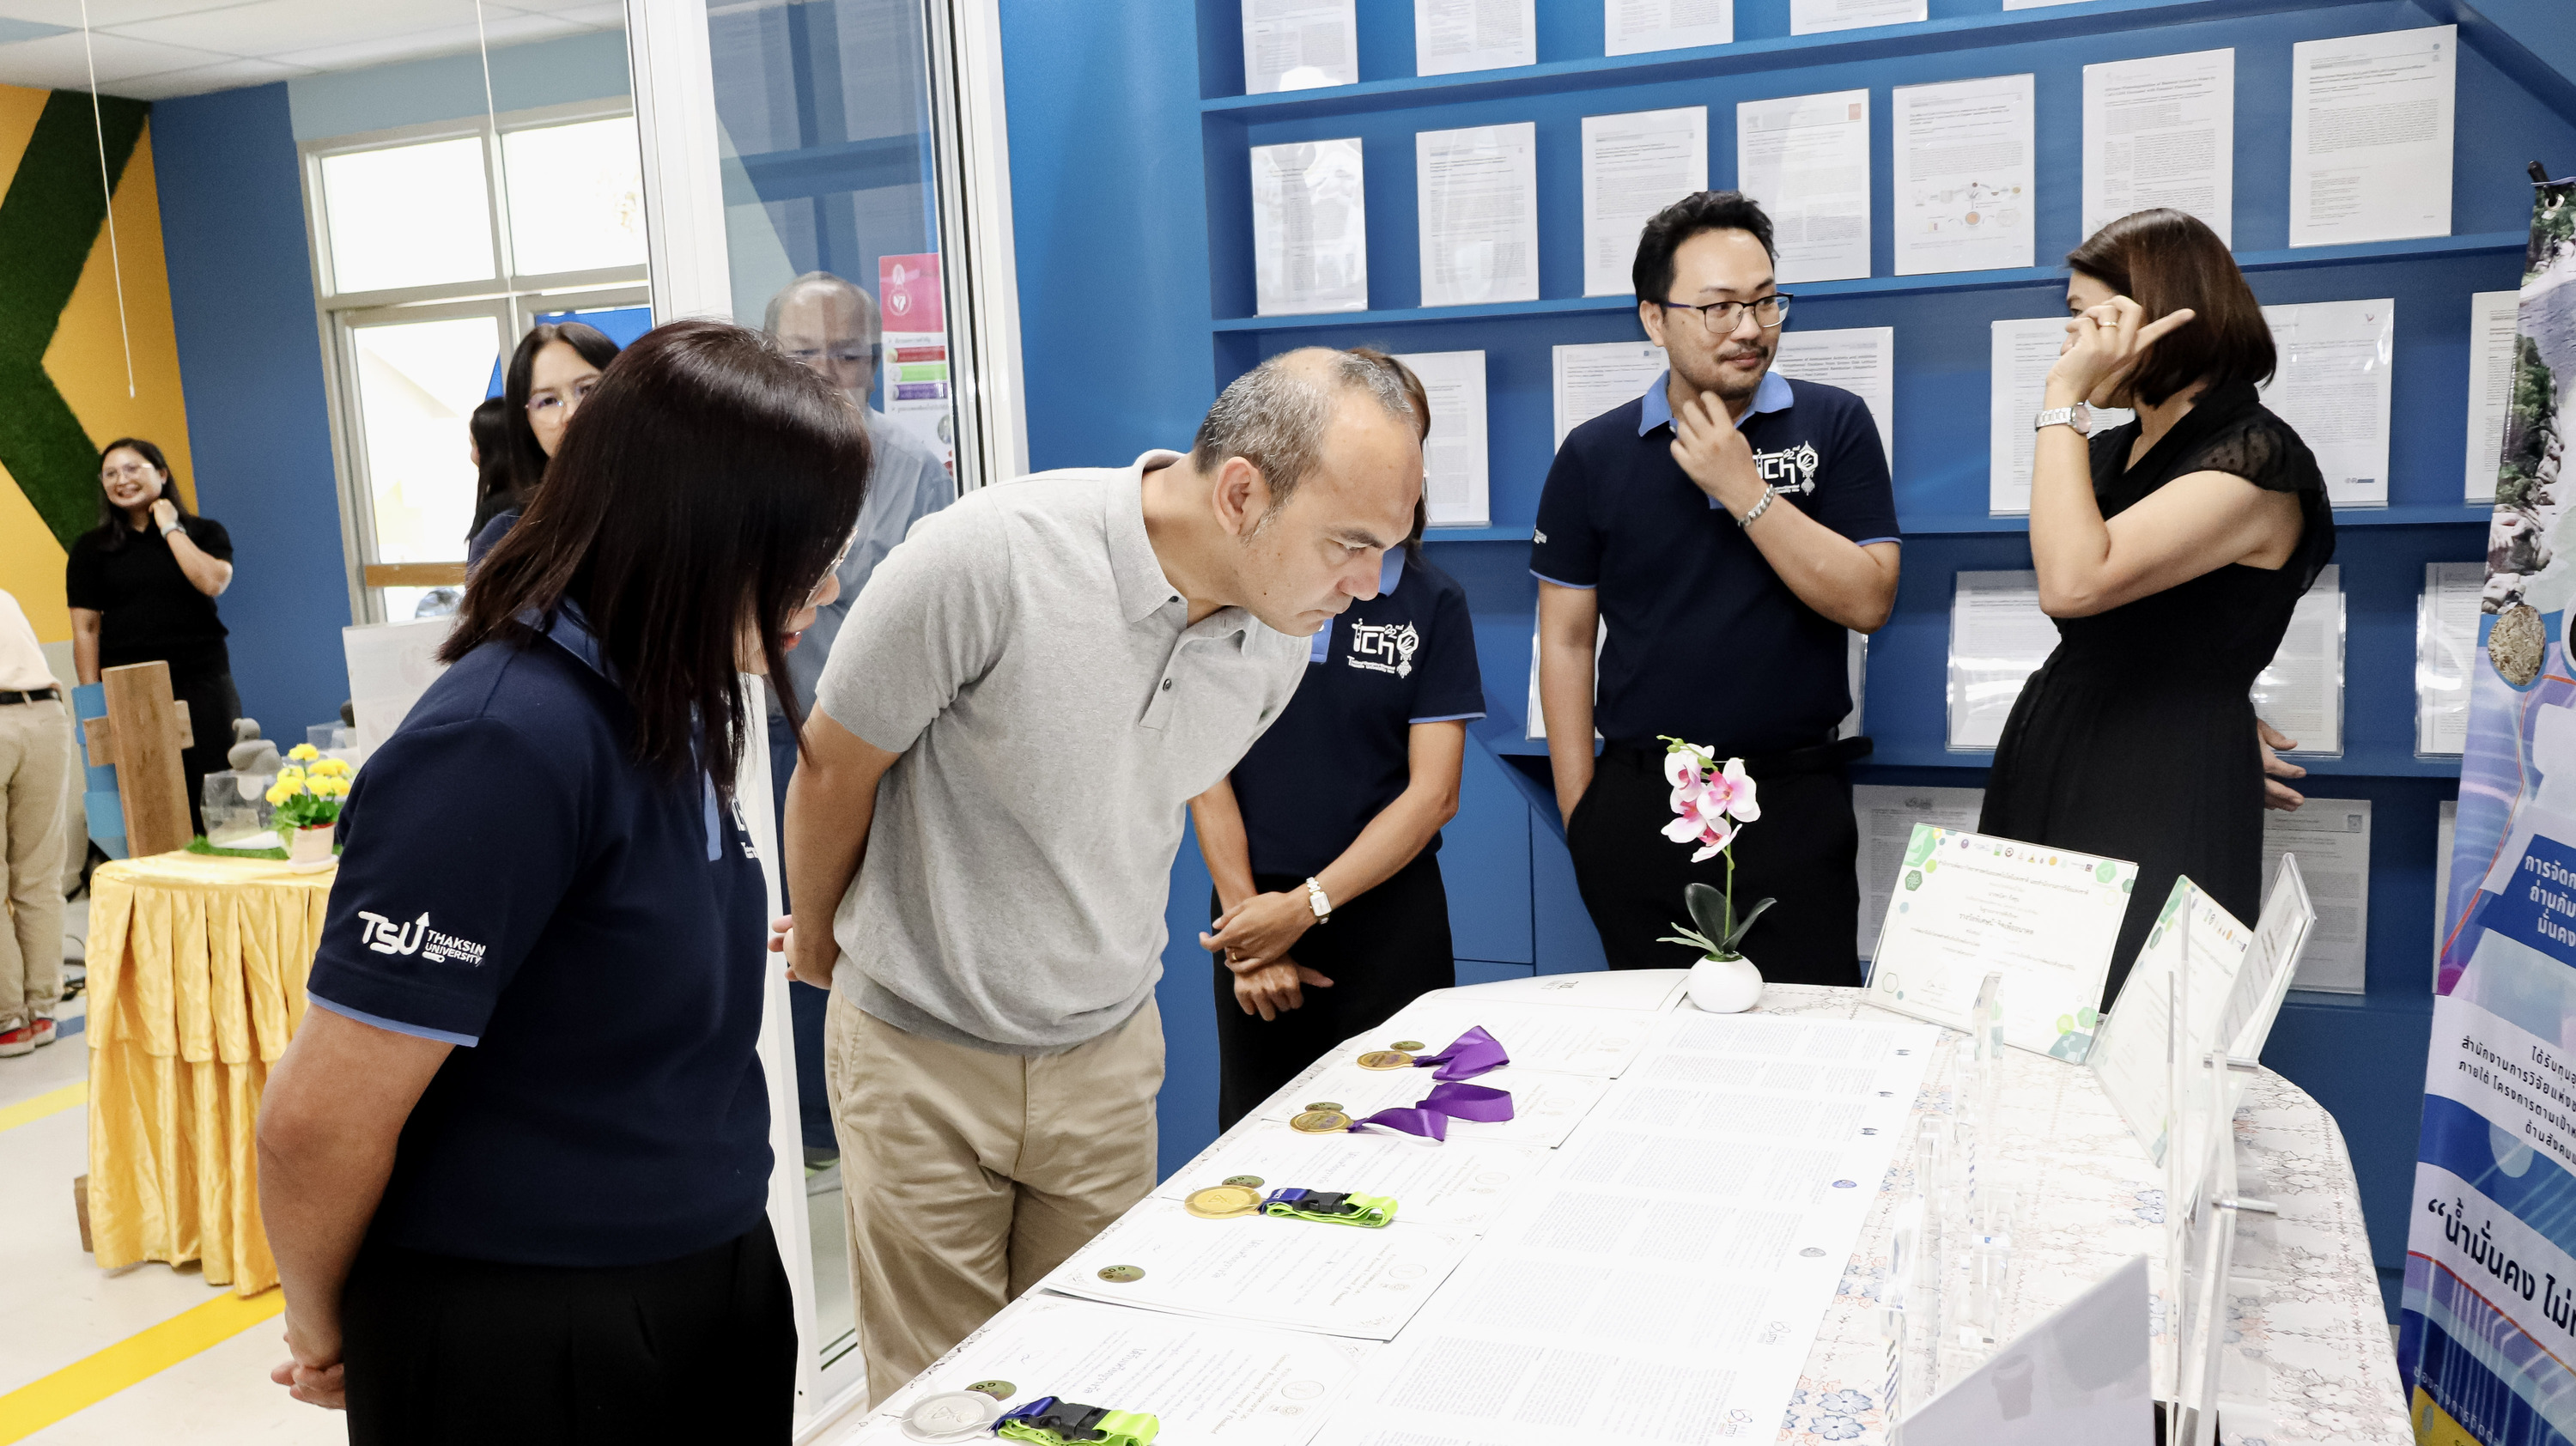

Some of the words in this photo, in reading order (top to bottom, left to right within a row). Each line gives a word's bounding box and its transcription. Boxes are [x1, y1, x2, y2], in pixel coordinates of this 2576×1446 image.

[358, 910, 429, 956] TSU
[428, 929, 486, 957] THAKSIN
[425, 942, 483, 965] UNIVERSITY
